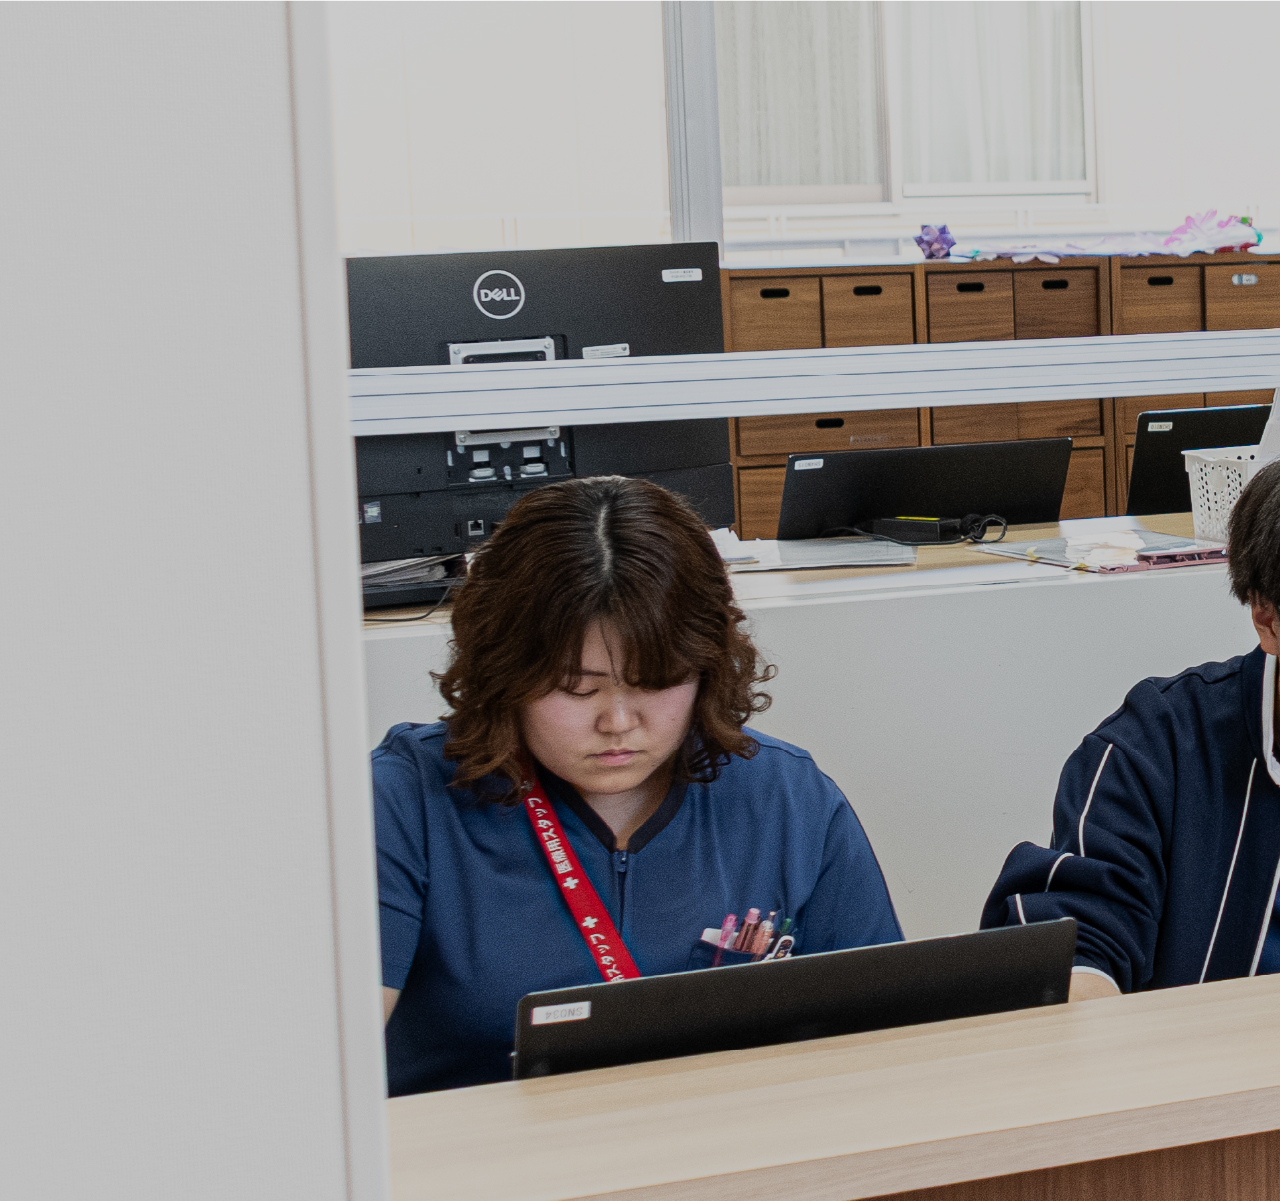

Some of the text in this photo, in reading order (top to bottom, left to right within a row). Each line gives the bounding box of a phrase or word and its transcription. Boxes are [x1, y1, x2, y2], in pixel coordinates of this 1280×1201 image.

[480, 288, 520, 301] DELL
[528, 797, 573, 874] 医療用スタッフ
[545, 1006, 584, 1020] SN034
